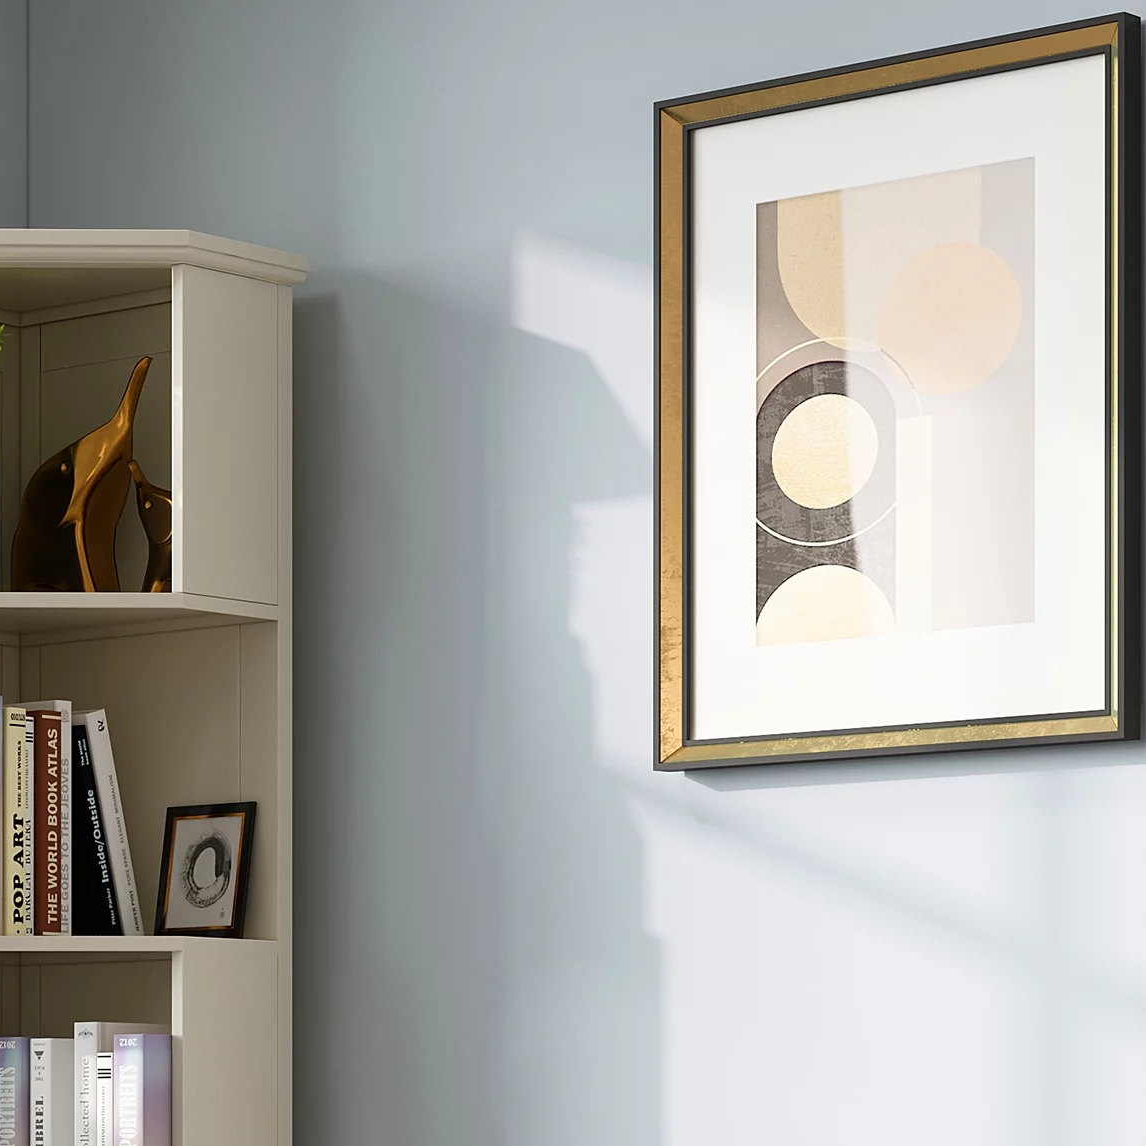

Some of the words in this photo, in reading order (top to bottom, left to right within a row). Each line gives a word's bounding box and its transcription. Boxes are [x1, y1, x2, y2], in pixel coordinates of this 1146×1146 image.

[47, 728, 58, 777] ATLAS
[47, 781, 58, 826] BOOK
[13, 813, 24, 867] ART
[61, 810, 69, 840] THE
[86, 789, 110, 883] Inside/Outside
[47, 830, 58, 889] WORLD
[61, 842, 69, 860] TO
[13, 874, 24, 924] POP
[61, 863, 69, 900] GOES
[47, 894, 58, 924] THE
[61, 904, 69, 934] LIFE
[0, 1041, 16, 1049] 2012
[119, 1038, 138, 1046] 2012
[80, 1058, 90, 1096] home
